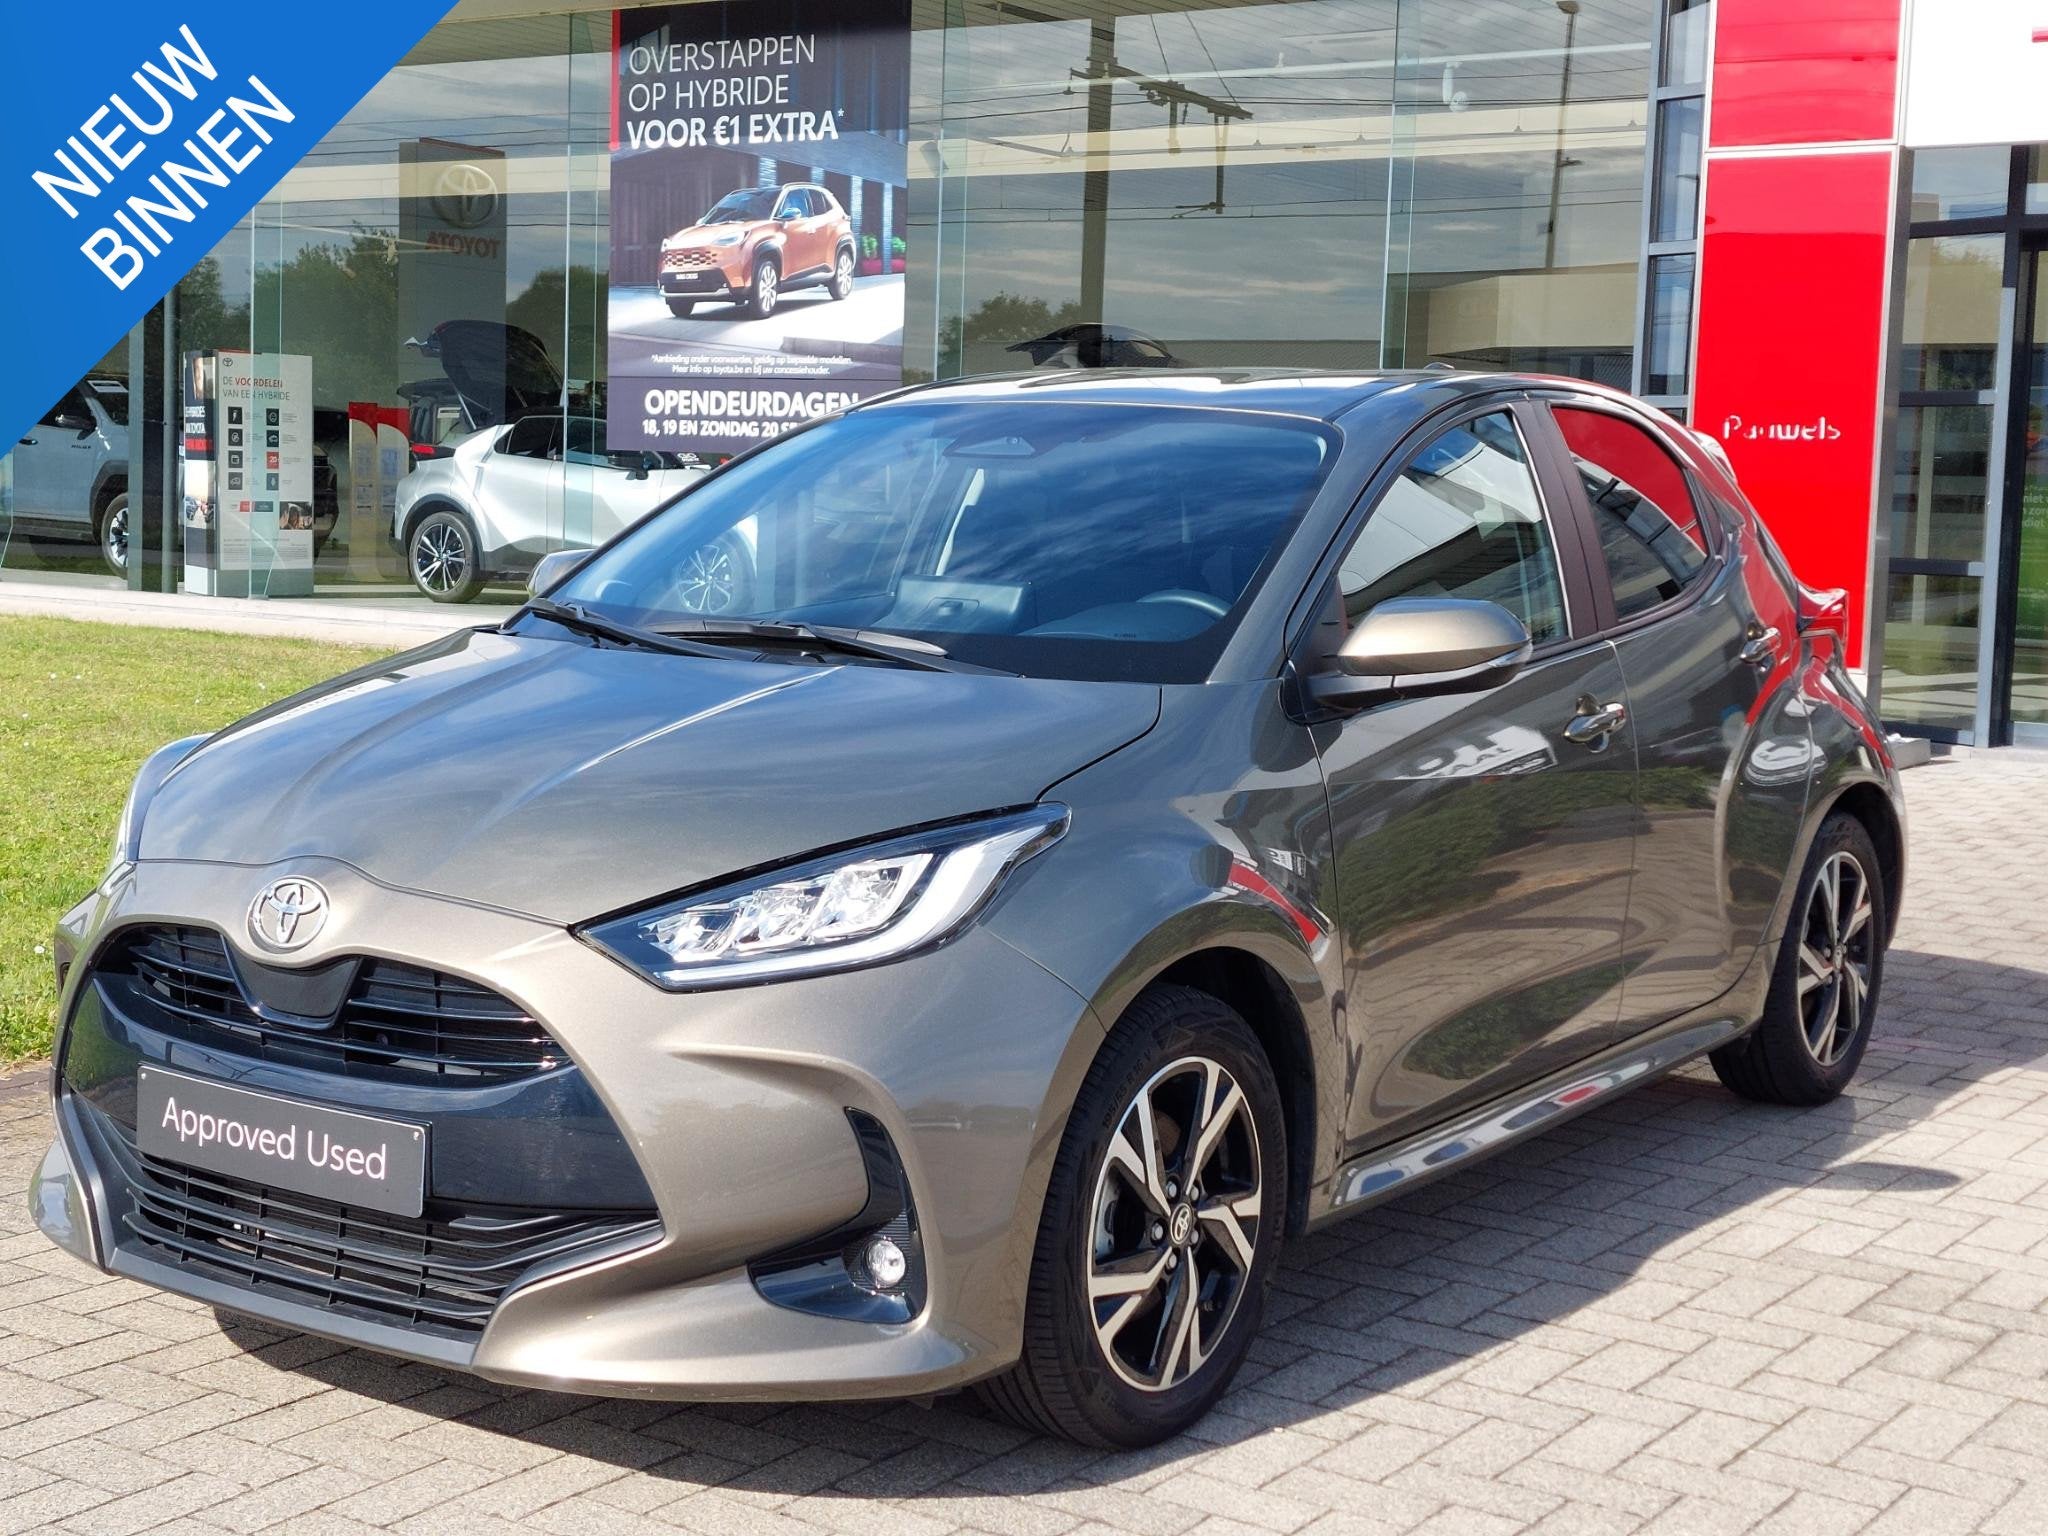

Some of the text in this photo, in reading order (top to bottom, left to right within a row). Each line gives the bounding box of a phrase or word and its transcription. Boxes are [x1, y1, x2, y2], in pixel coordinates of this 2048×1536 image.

[629, 34, 816, 75] OVERSTAPPEN
[628, 74, 790, 113] OP HYBRIDE
[627, 116, 707, 150] VOOR
[712, 115, 741, 146] €1
[222, 376, 233, 386] DE
[703, 366, 712, 374] op
[222, 389, 239, 398] VAN
[642, 419, 660, 437] 18,
[662, 419, 678, 435] 19
[678, 420, 698, 436] EN
[699, 420, 760, 437] ZONDAG
[761, 421, 779, 437] 20
[161, 1096, 387, 1181] Approved Used
